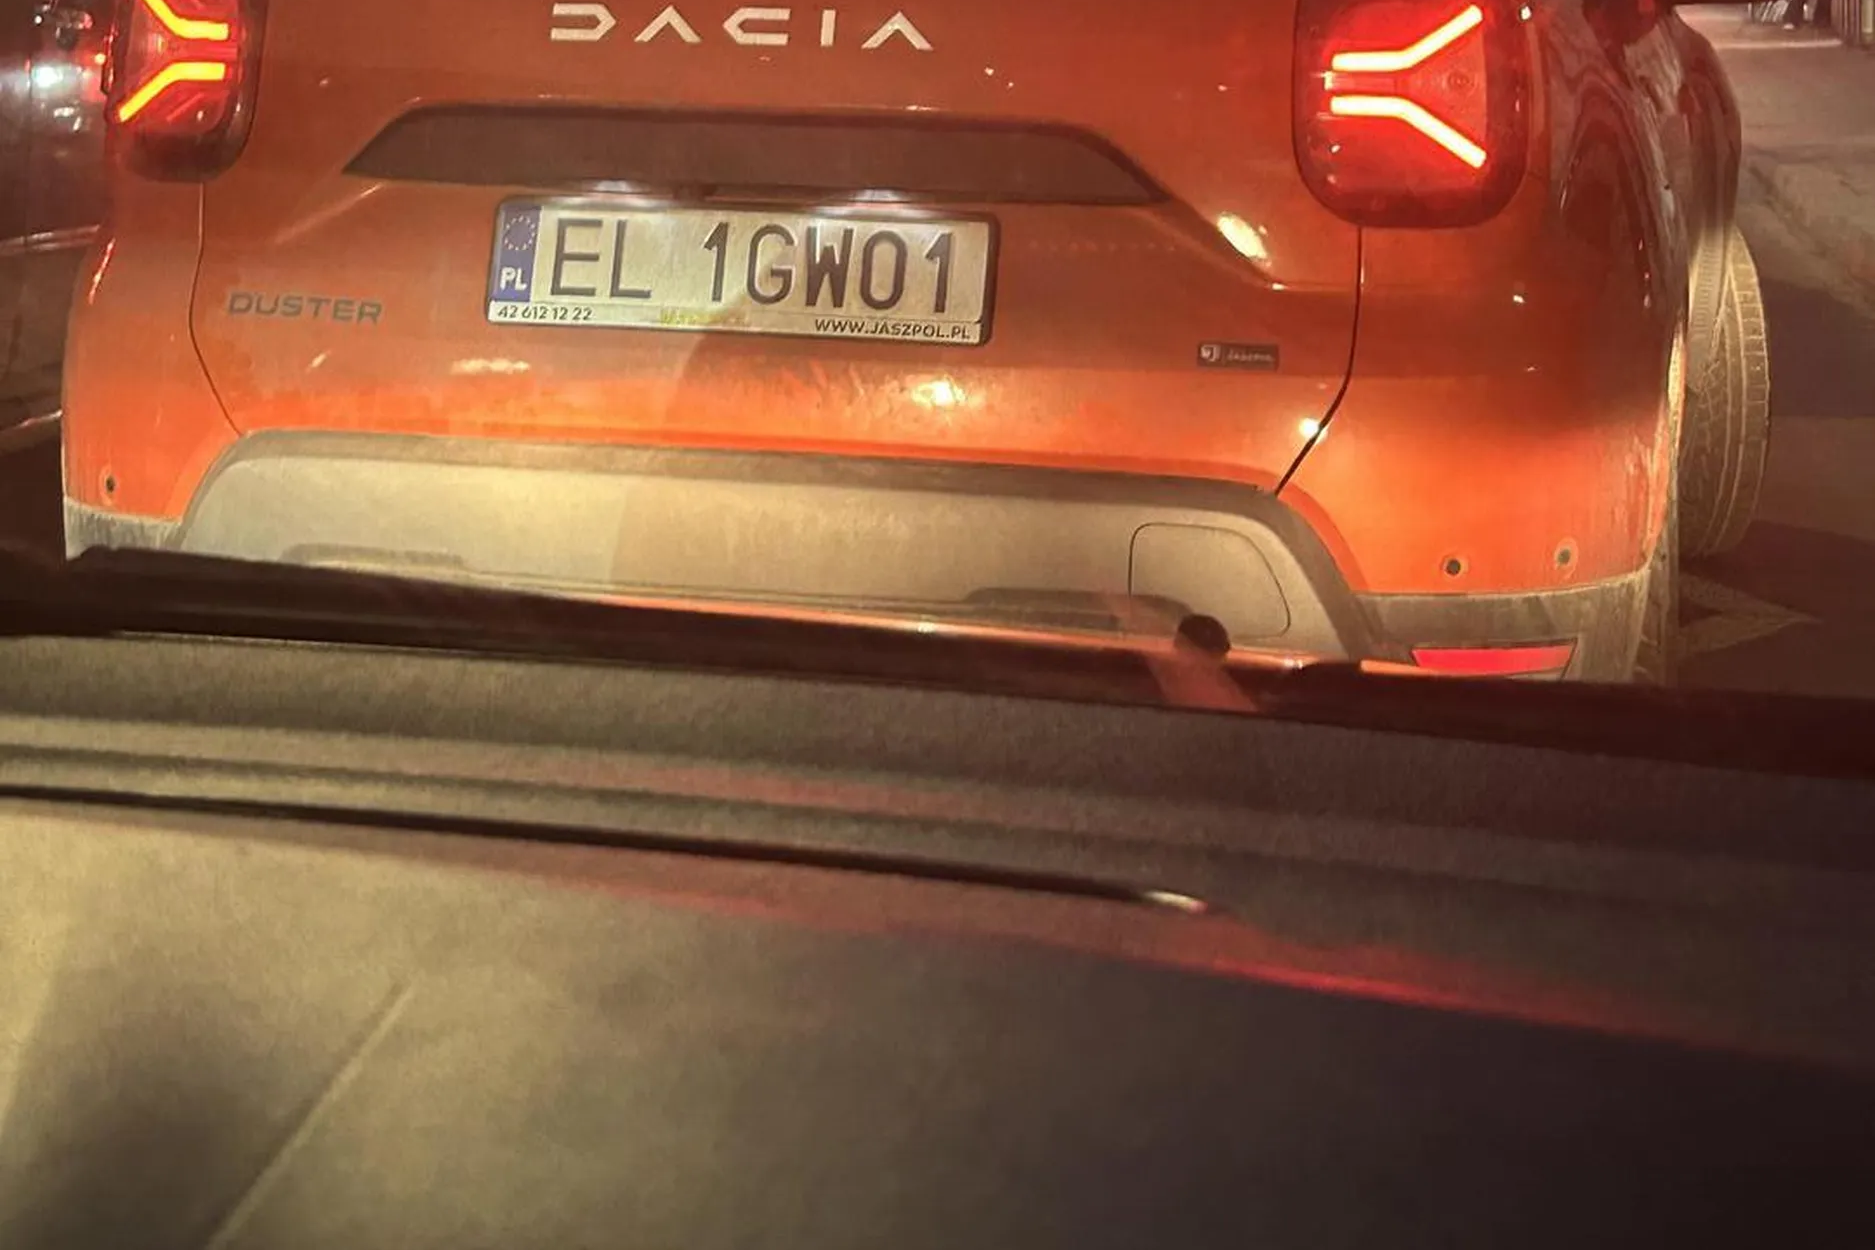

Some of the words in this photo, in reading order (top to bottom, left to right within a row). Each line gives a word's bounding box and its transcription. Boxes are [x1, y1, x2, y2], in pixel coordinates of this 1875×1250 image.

[550, 2, 934, 51] DACIA
[499, 266, 528, 292] PL
[550, 217, 652, 299] EL
[703, 220, 952, 314] 1GW01
[228, 291, 383, 325] DUSTER
[497, 304, 517, 318] 42
[521, 305, 548, 319] 612
[552, 306, 569, 320] 12
[572, 307, 592, 321] 22
[815, 318, 971, 340] WWW.JASZPOL.PL
